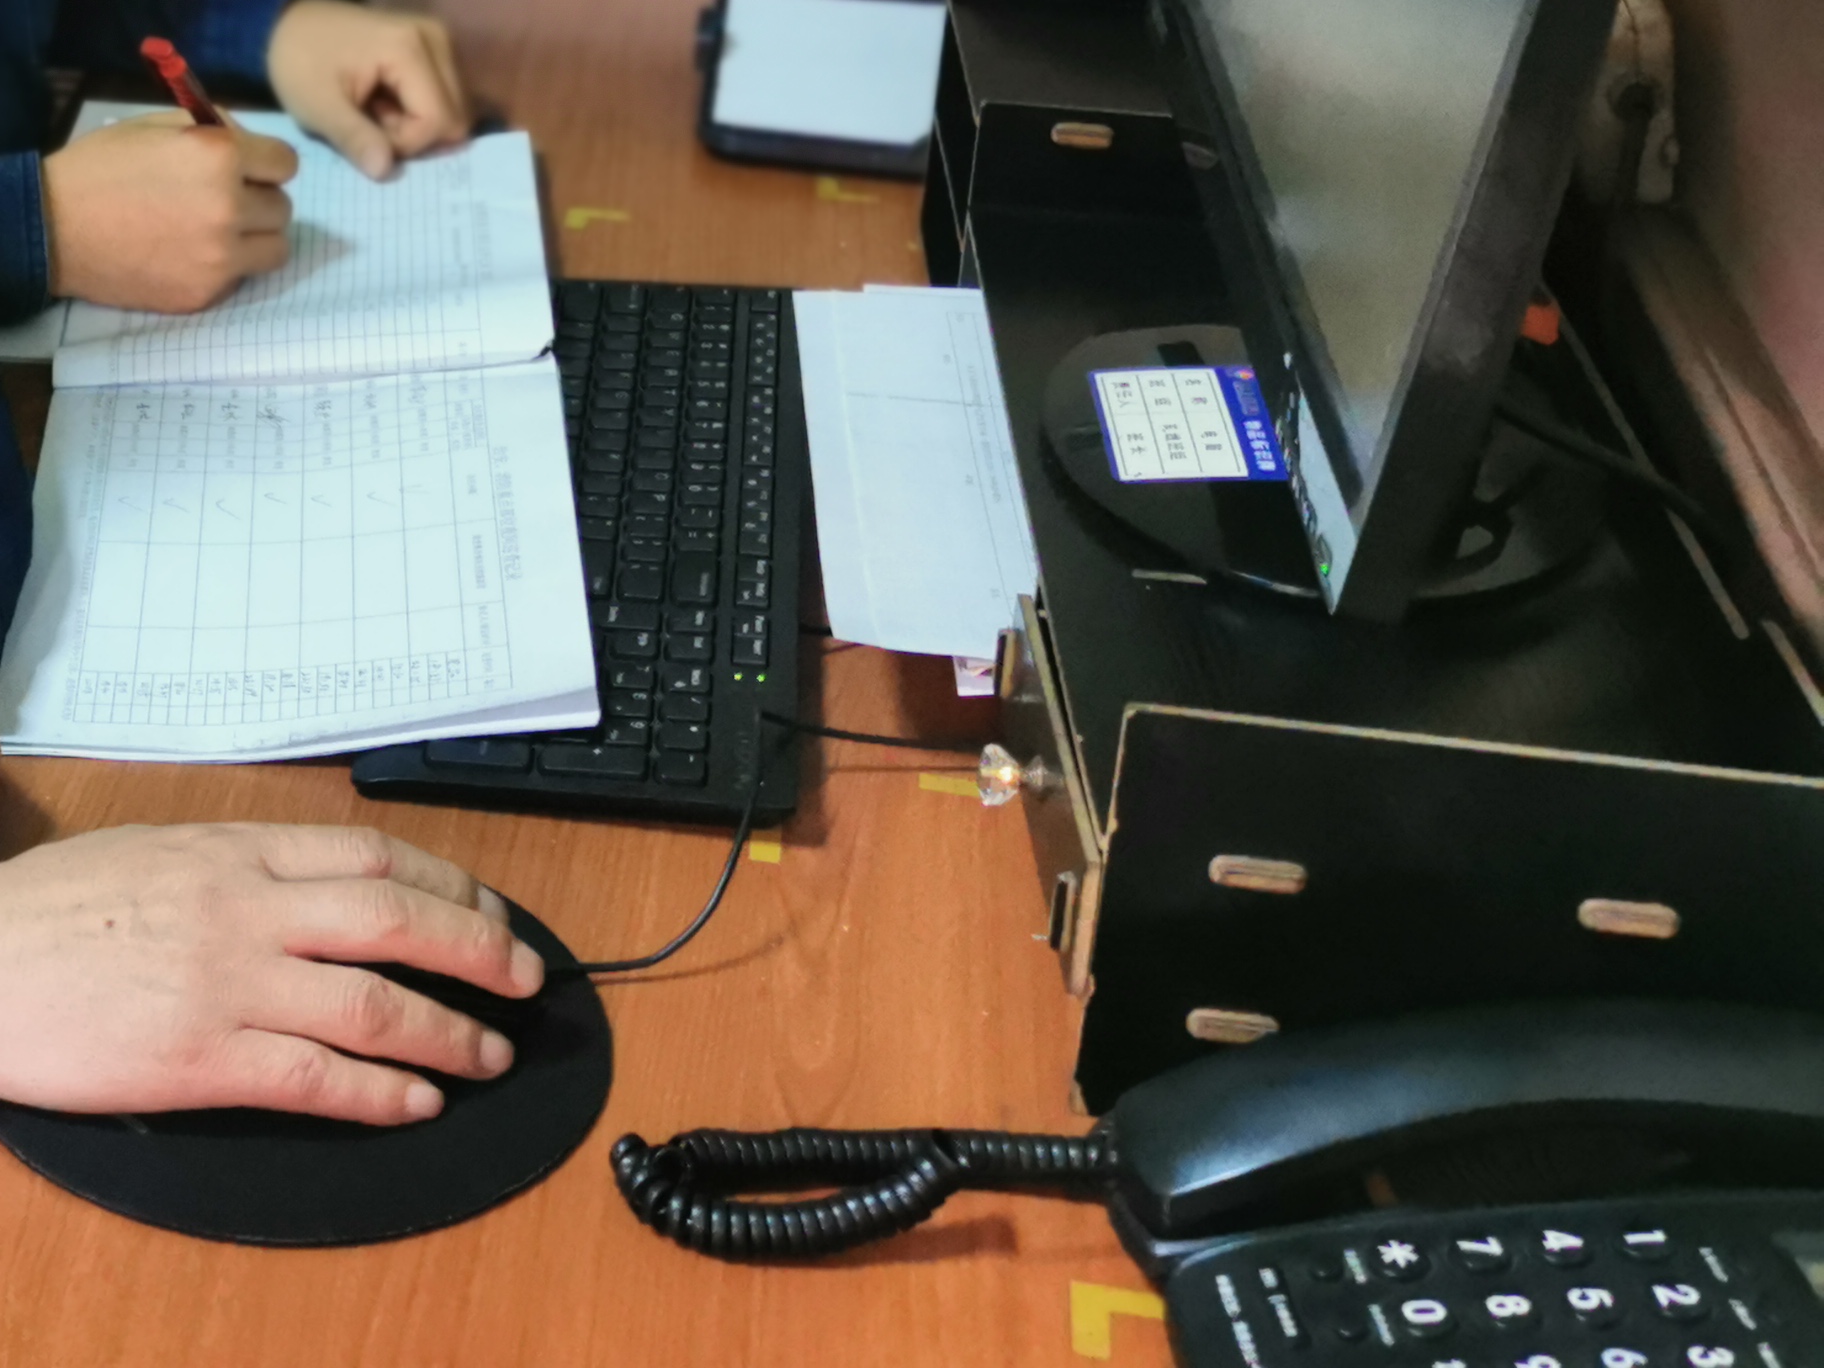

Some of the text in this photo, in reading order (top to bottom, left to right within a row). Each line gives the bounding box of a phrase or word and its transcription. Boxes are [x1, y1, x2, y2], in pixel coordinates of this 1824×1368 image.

[1456, 1235, 1504, 1256] 7
[1542, 1229, 1584, 1252] 4
[1623, 1229, 1667, 1245] 1
[1485, 1293, 1533, 1318] 8
[1566, 1286, 1614, 1310] 5
[1652, 1282, 1701, 1309] 2
[1400, 1298, 1448, 1325] 0
[1600, 1346, 1648, 1368] 6
[1686, 1344, 1736, 1368] 3
